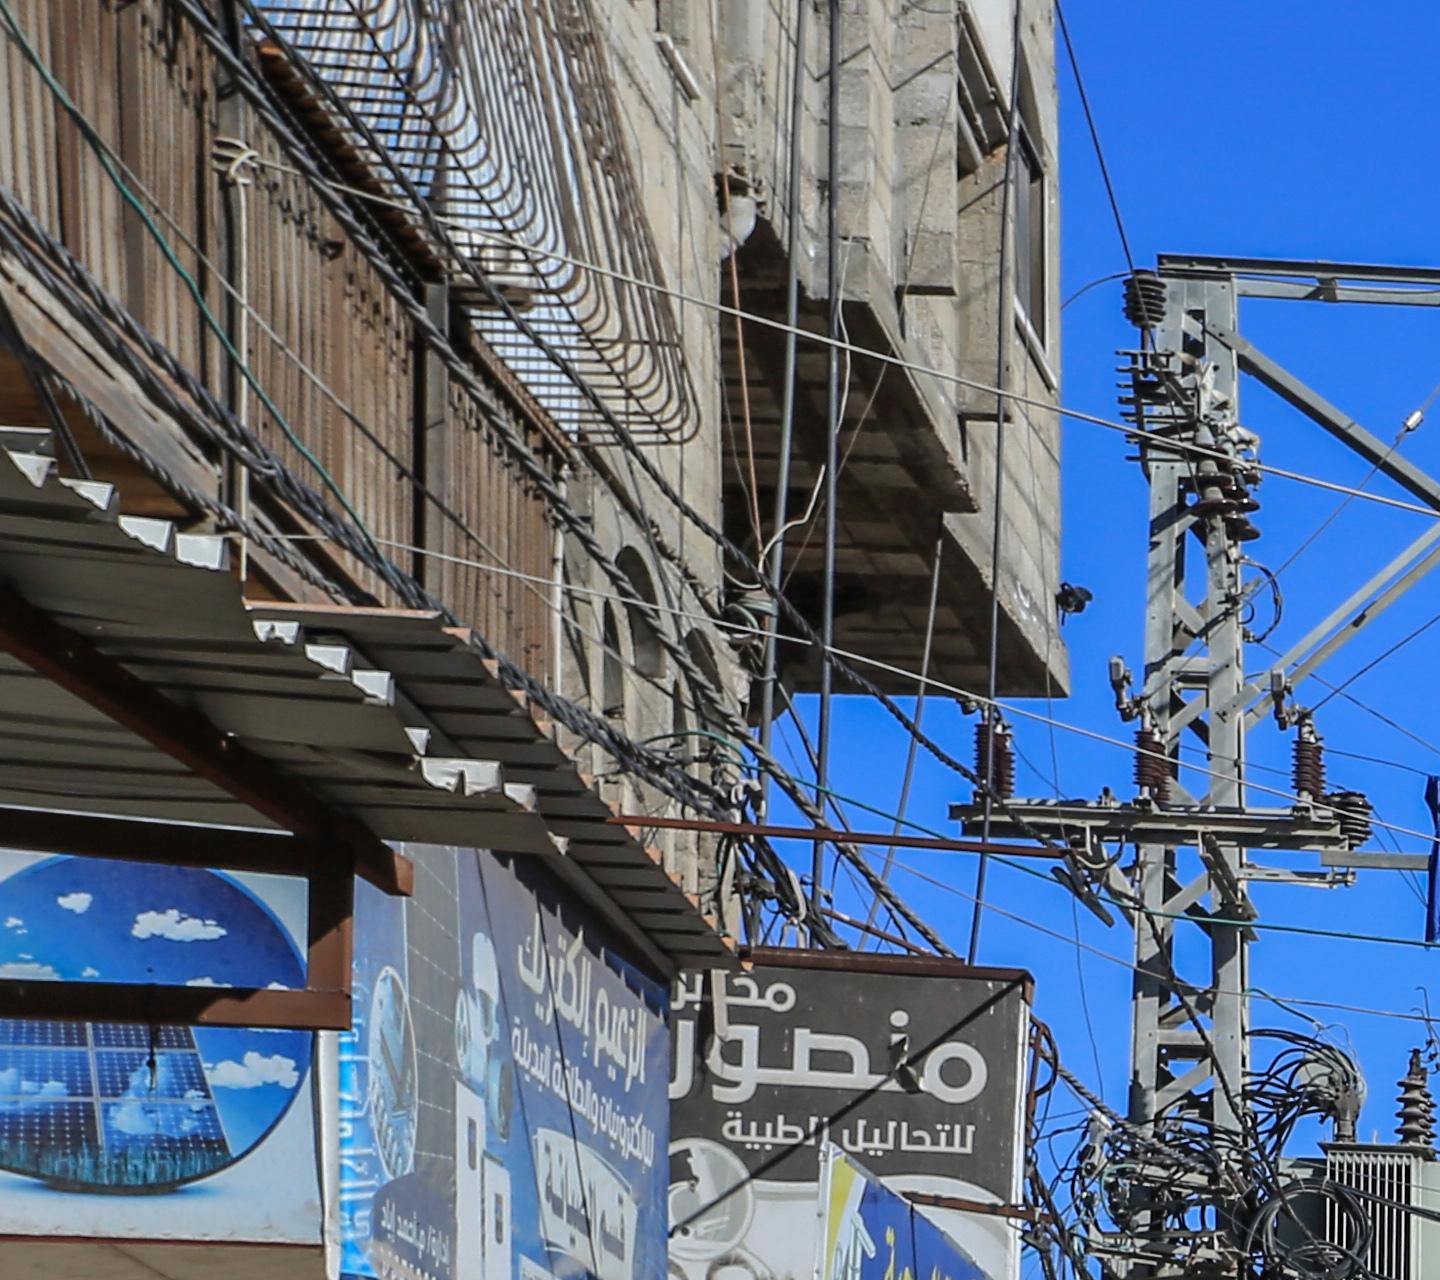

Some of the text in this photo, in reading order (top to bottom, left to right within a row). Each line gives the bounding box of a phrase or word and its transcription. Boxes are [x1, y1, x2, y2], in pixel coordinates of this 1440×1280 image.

[511, 1017, 551, 1091] البديلة
[595, 987, 646, 1092] الزعيم
[669, 1011, 988, 1104] منصور
[722, 1111, 975, 1156] للتحاليل الطبية
